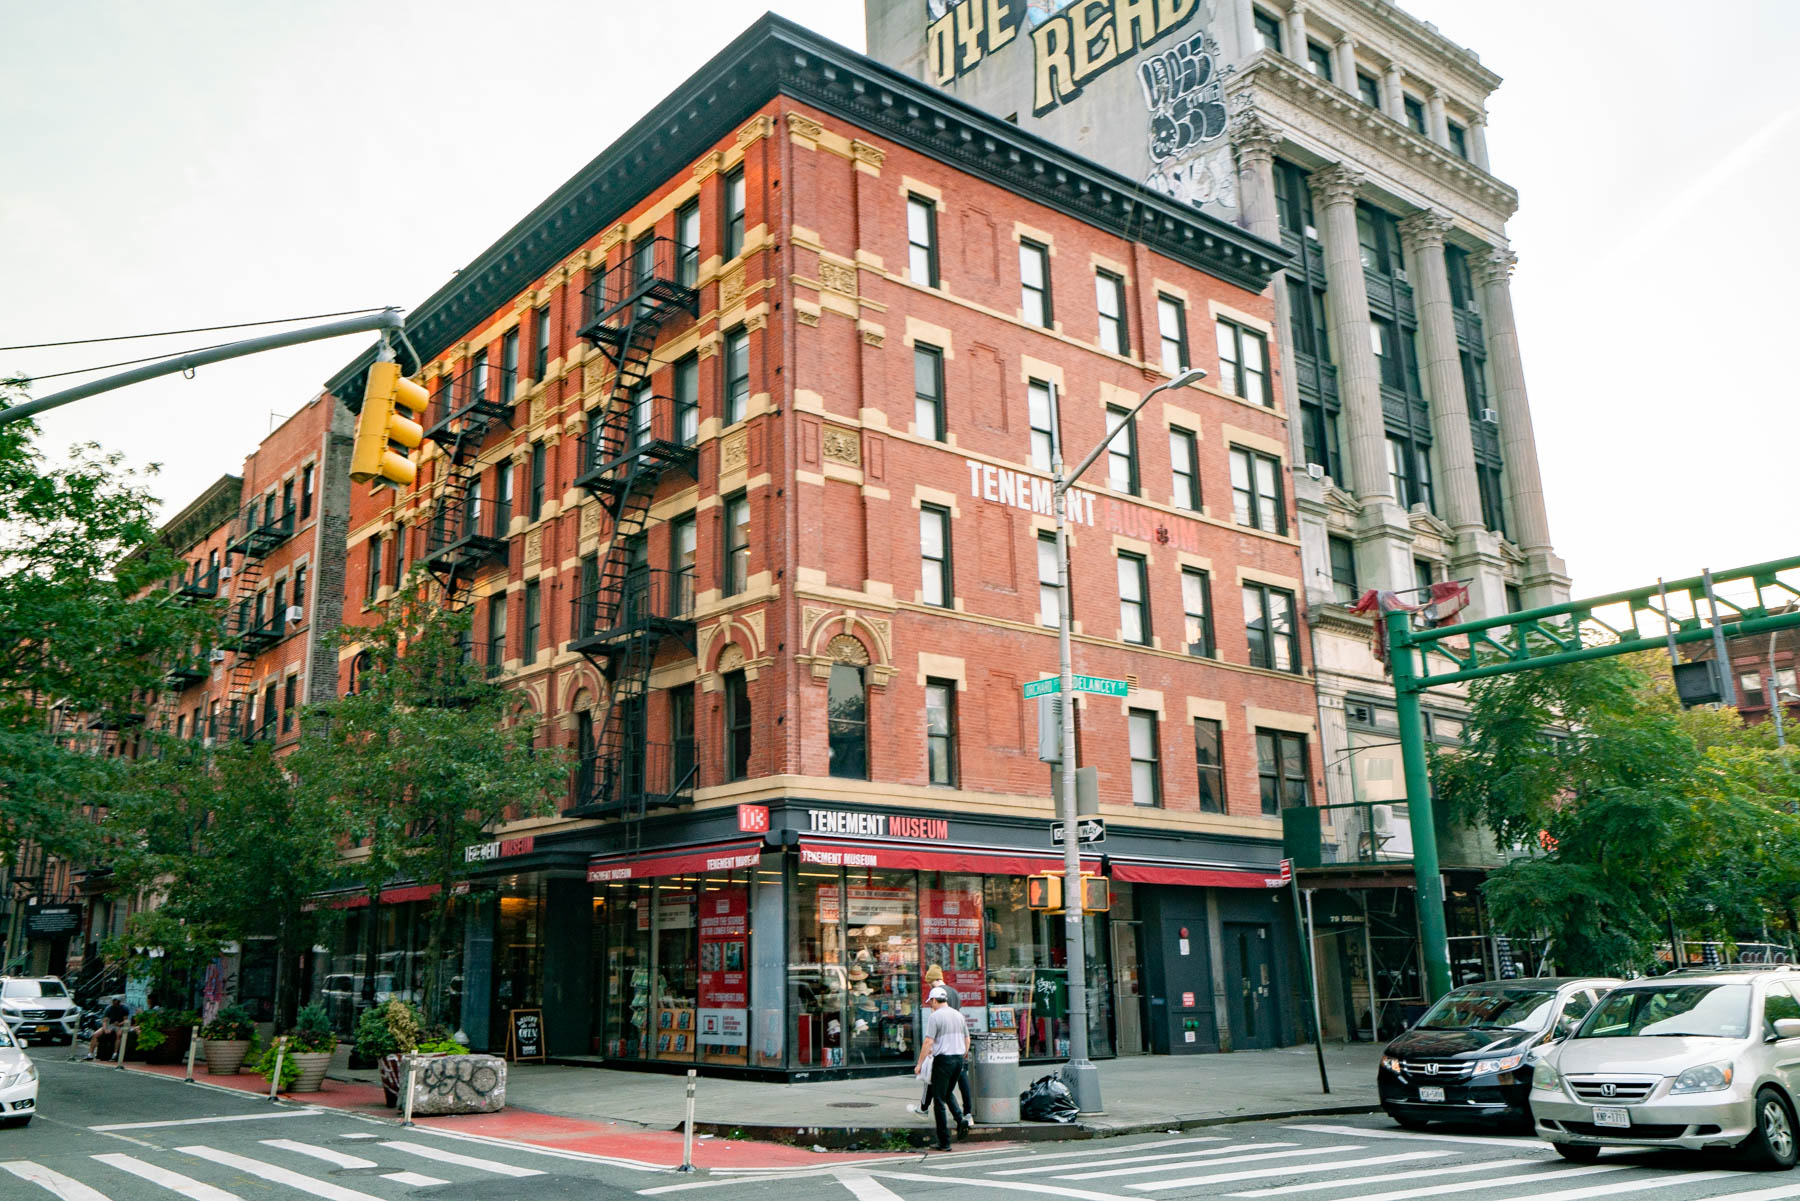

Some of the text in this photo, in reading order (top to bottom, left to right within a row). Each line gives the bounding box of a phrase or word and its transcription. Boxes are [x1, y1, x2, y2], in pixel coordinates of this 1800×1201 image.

[966, 459, 1096, 527] TENEMNT
[1072, 677, 1116, 693] DELANCEY
[808, 810, 948, 839] TENEMENT MUSEUM
[1082, 825, 1098, 836] WAY
[801, 850, 877, 866] TENEMENT MUSEUM
